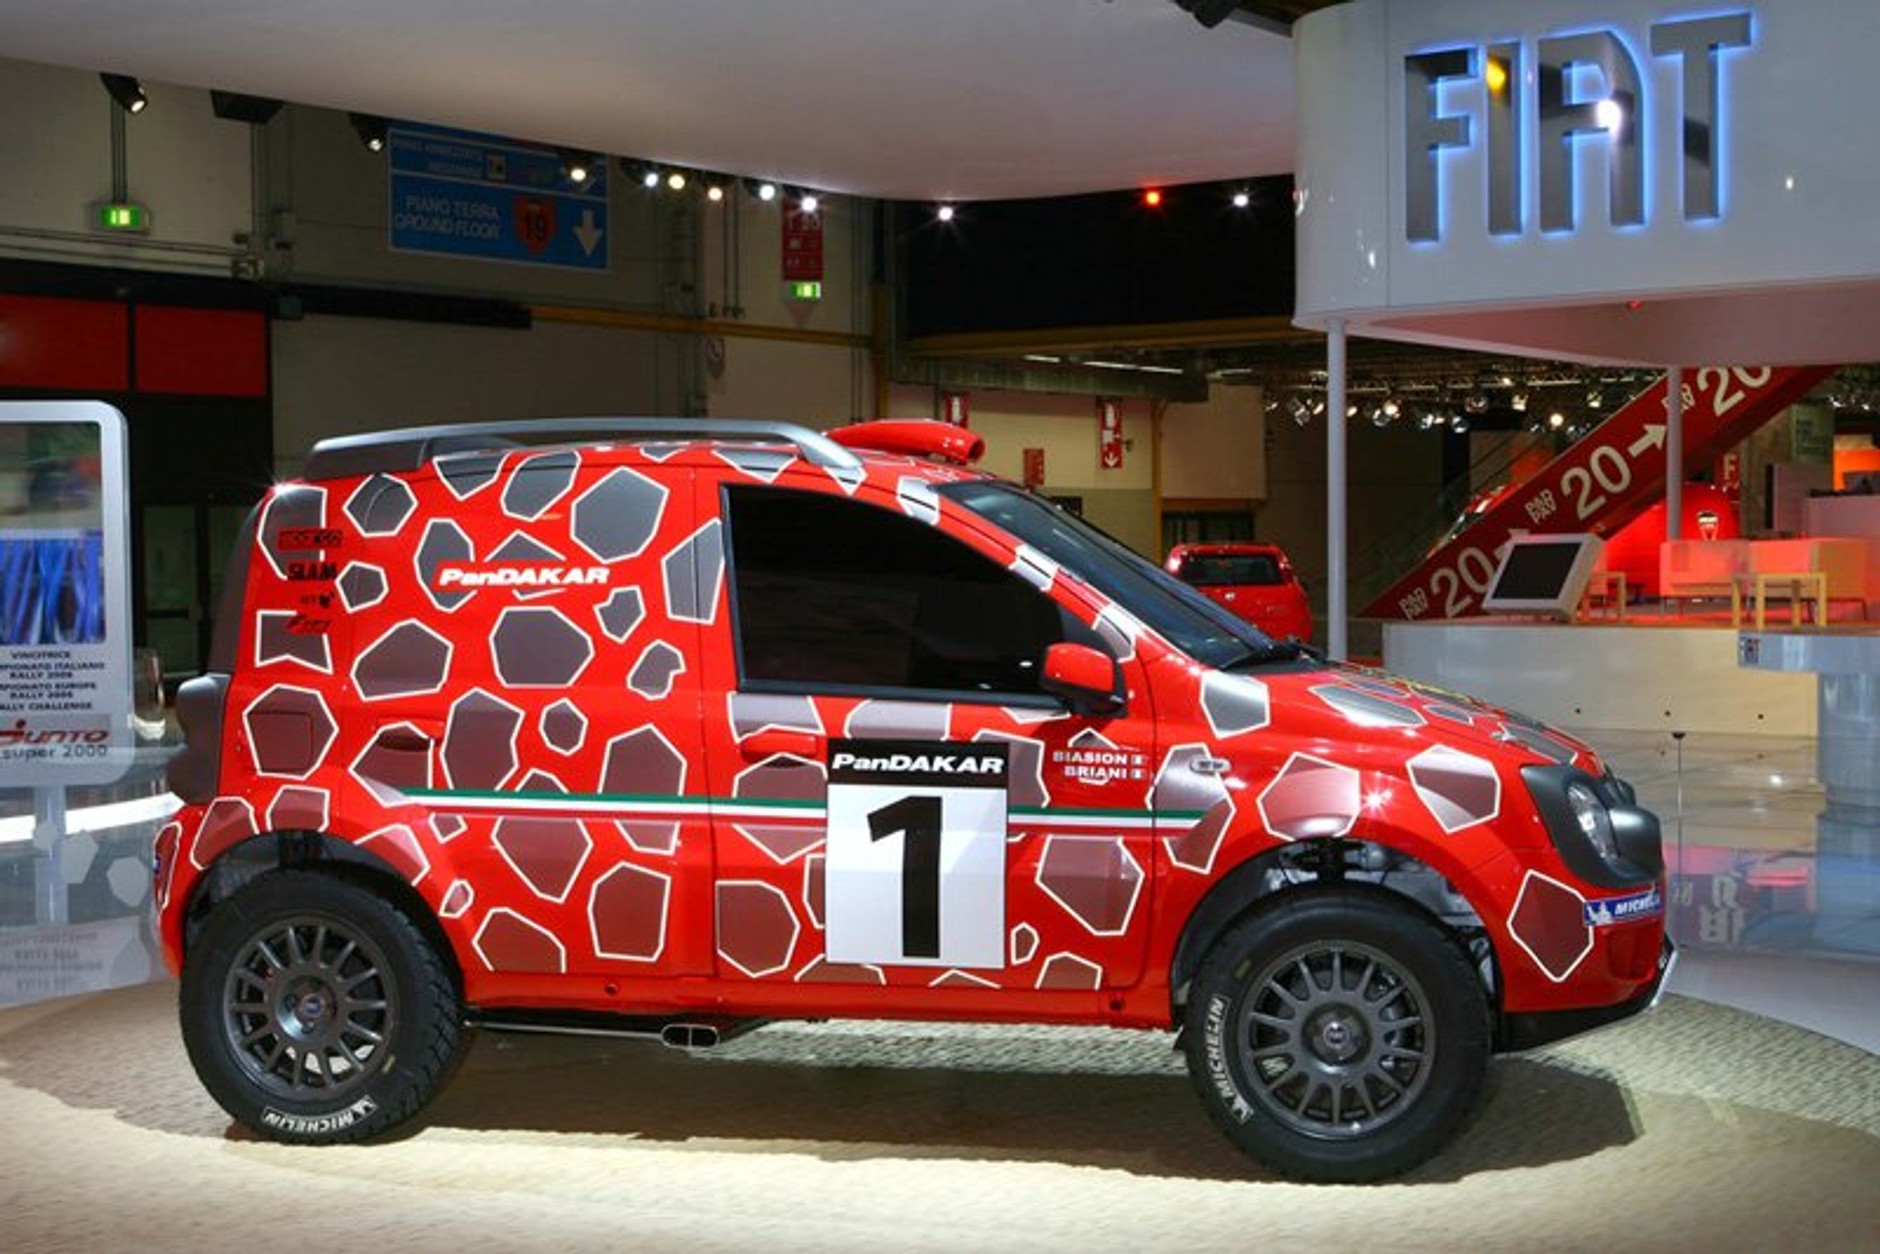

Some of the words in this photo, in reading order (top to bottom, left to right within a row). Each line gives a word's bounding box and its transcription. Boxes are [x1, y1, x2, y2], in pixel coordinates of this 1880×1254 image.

[1403, 12, 1753, 243] FIAT
[406, 194, 451, 215] PIANO
[454, 200, 500, 220] TERRA
[394, 212, 453, 235] GROUND
[454, 219, 500, 240] FLOOR
[1560, 445, 1633, 520] 20
[439, 567, 610, 586] PanDAKAR
[1430, 546, 1494, 618] 20
[10, 671, 44, 679] RALLY
[28, 702, 92, 711] CHALLENGE
[62, 743, 108, 758] 2000
[1053, 752, 1128, 765] BIASION
[832, 753, 1004, 774] PanDAKAR
[1065, 766, 1127, 779] BRIANI
[867, 795, 943, 959] 1
[1206, 997, 1235, 1099] MICHELIN
[264, 1109, 354, 1133] MICHELIN
